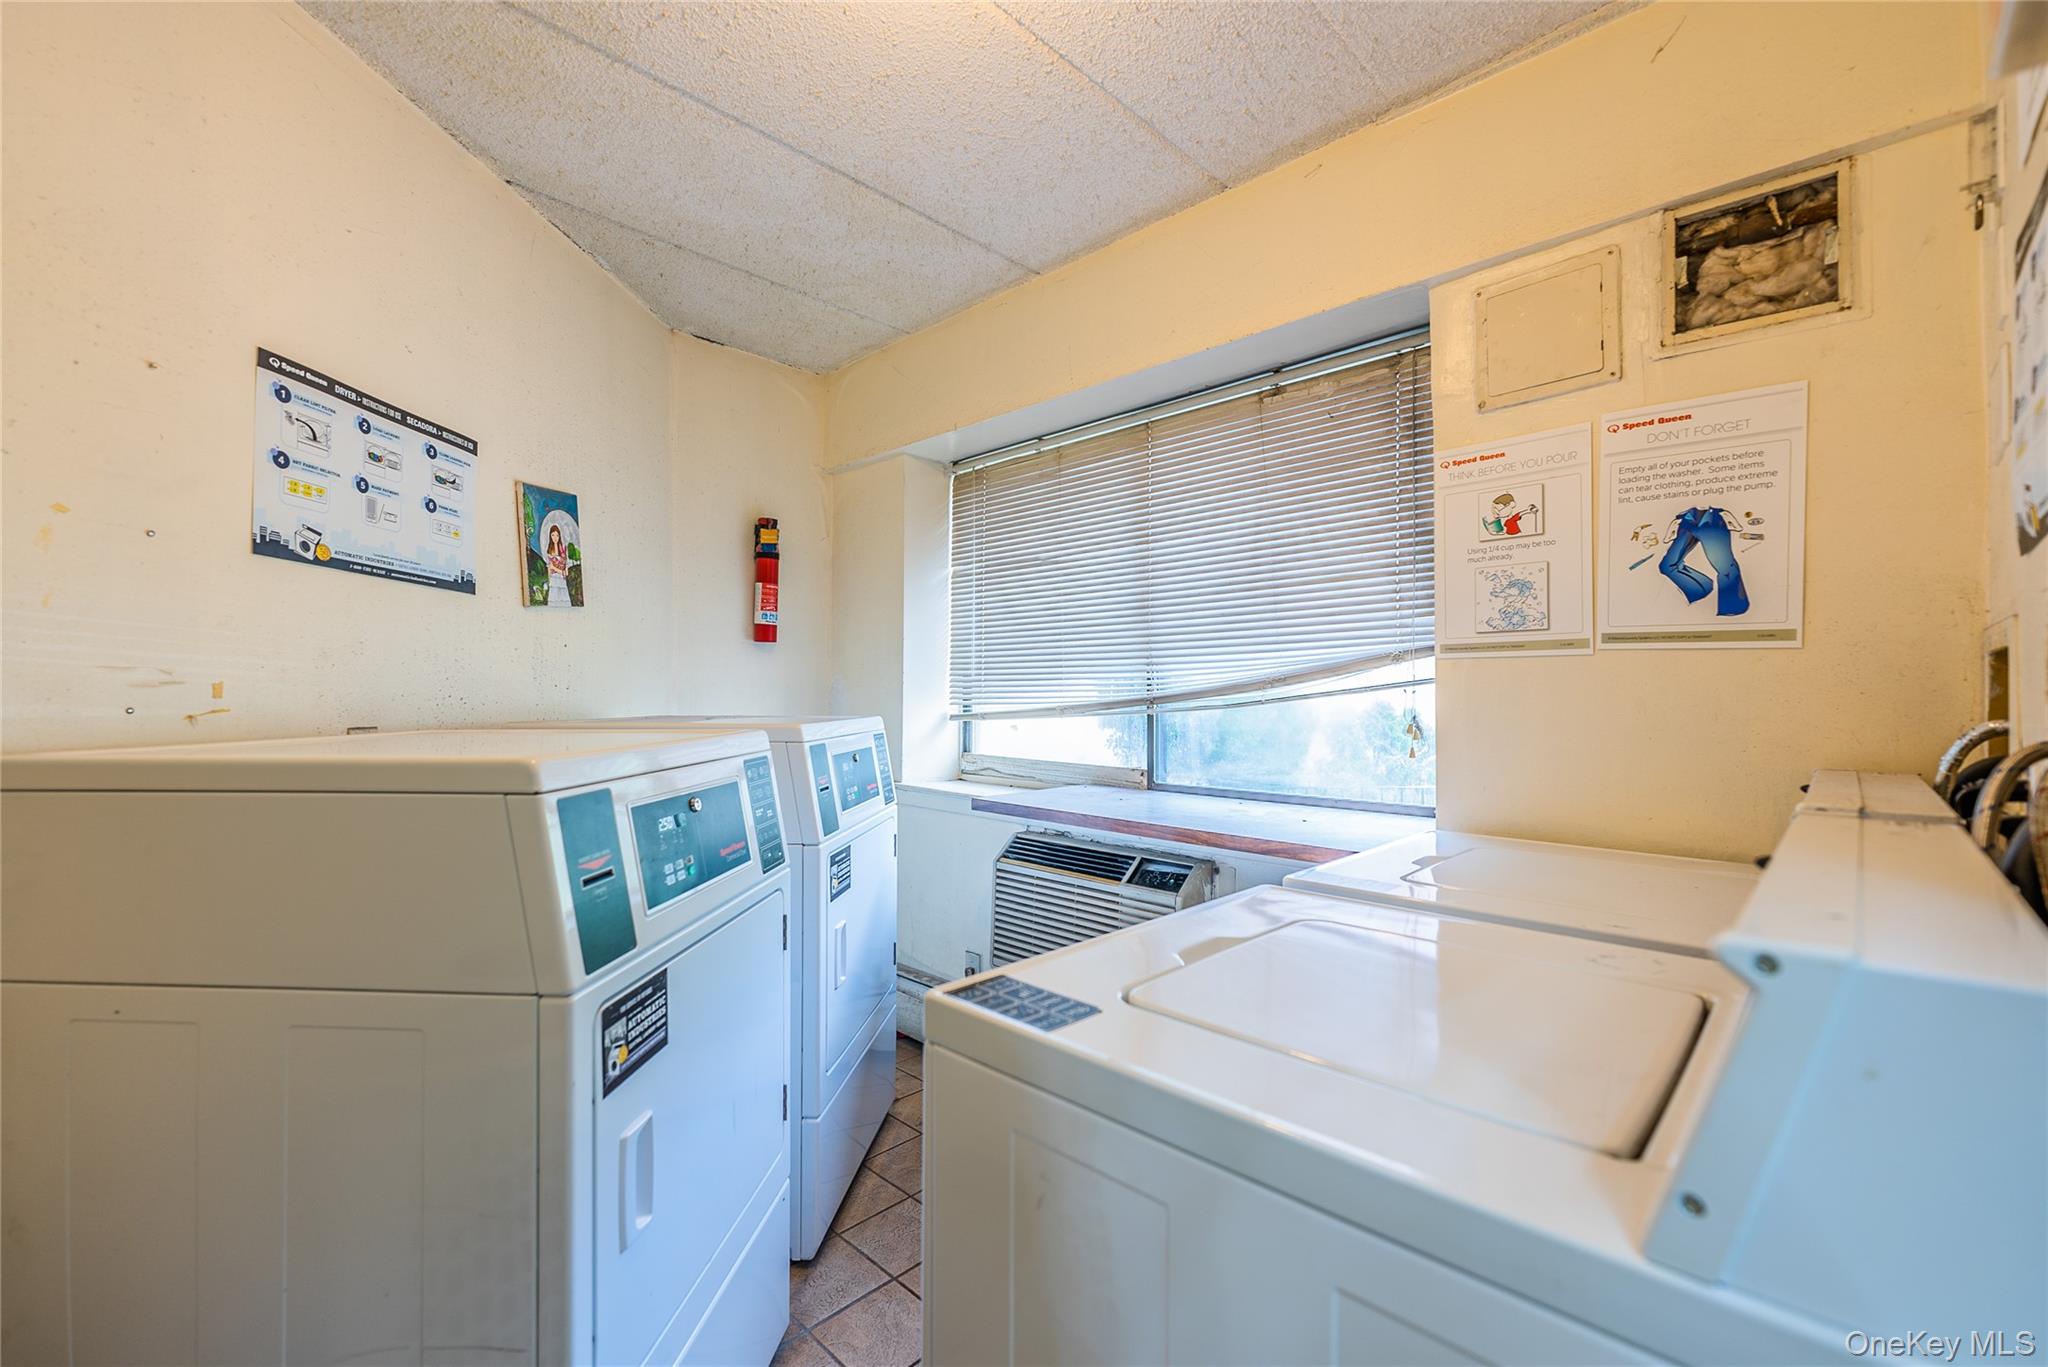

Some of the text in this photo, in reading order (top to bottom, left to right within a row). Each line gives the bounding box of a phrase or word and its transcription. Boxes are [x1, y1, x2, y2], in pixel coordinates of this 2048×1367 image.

[281, 362, 305, 377] Speed
[306, 372, 328, 387] Queen
[334, 385, 357, 401] DRYER
[406, 416, 438, 435] SECADORA
[1622, 418, 1655, 430] Speed
[1658, 414, 1692, 424] Queen
[1647, 418, 1751, 444] DON'T FORGET
[1449, 450, 1578, 481] THINK BEFORE YOU POUR
[1452, 456, 1477, 468] Speed
[1480, 452, 1506, 462] Queen
[1618, 466, 1646, 476] Empty
[1670, 460, 1691, 470] your
[1692, 454, 1731, 467] pockets
[1732, 450, 1765, 460] before
[1618, 460, 1765, 484] loading the washer. Some items
[1618, 470, 1779, 494] can tear clothing, produce extreme
[1618, 495, 1634, 504] lint,
[1635, 492, 1663, 503] cause
[1663, 490, 1690, 500] stains
[1703, 486, 1725, 496] plug
[1726, 484, 1742, 492] the
[1744, 480, 1776, 492] pump.
[1467, 547, 1488, 556] Using
[1500, 544, 1514, 553] cup
[1515, 542, 1531, 551] may
